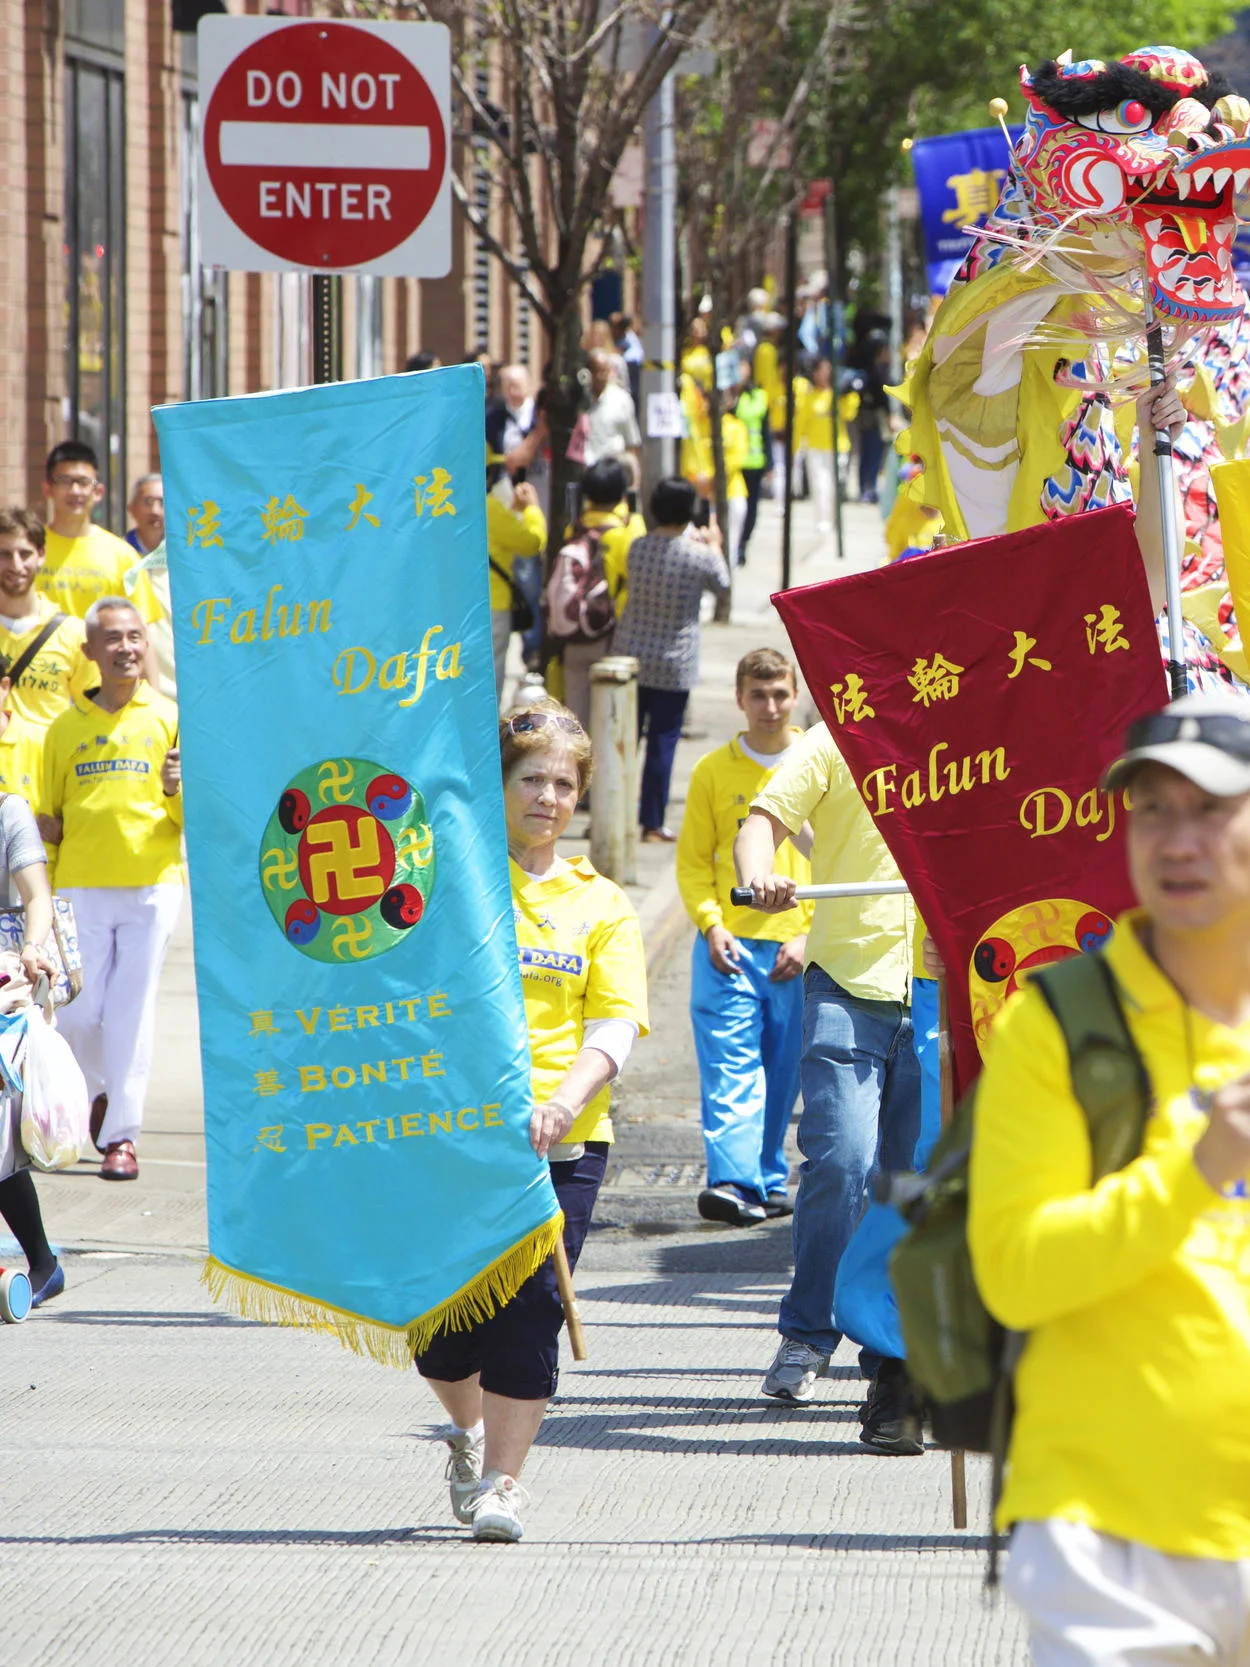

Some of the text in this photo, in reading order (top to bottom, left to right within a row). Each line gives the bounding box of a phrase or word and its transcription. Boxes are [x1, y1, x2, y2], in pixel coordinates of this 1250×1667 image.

[247, 70, 401, 110] DO NOT
[259, 181, 392, 221] ENTER
[186, 467, 456, 549] 法輪大法
[191, 584, 332, 645] Falun
[331, 624, 464, 708] Dafa
[829, 604, 1130, 725] 法輪大法
[862, 742, 1012, 817] Falun
[531, 951, 578, 972] DAFA
[248, 989, 452, 1039] 真 VÉRITÉ
[253, 1048, 446, 1097] 善 BONTÉ
[253, 1102, 504, 1153] 忍 PATIENCE
